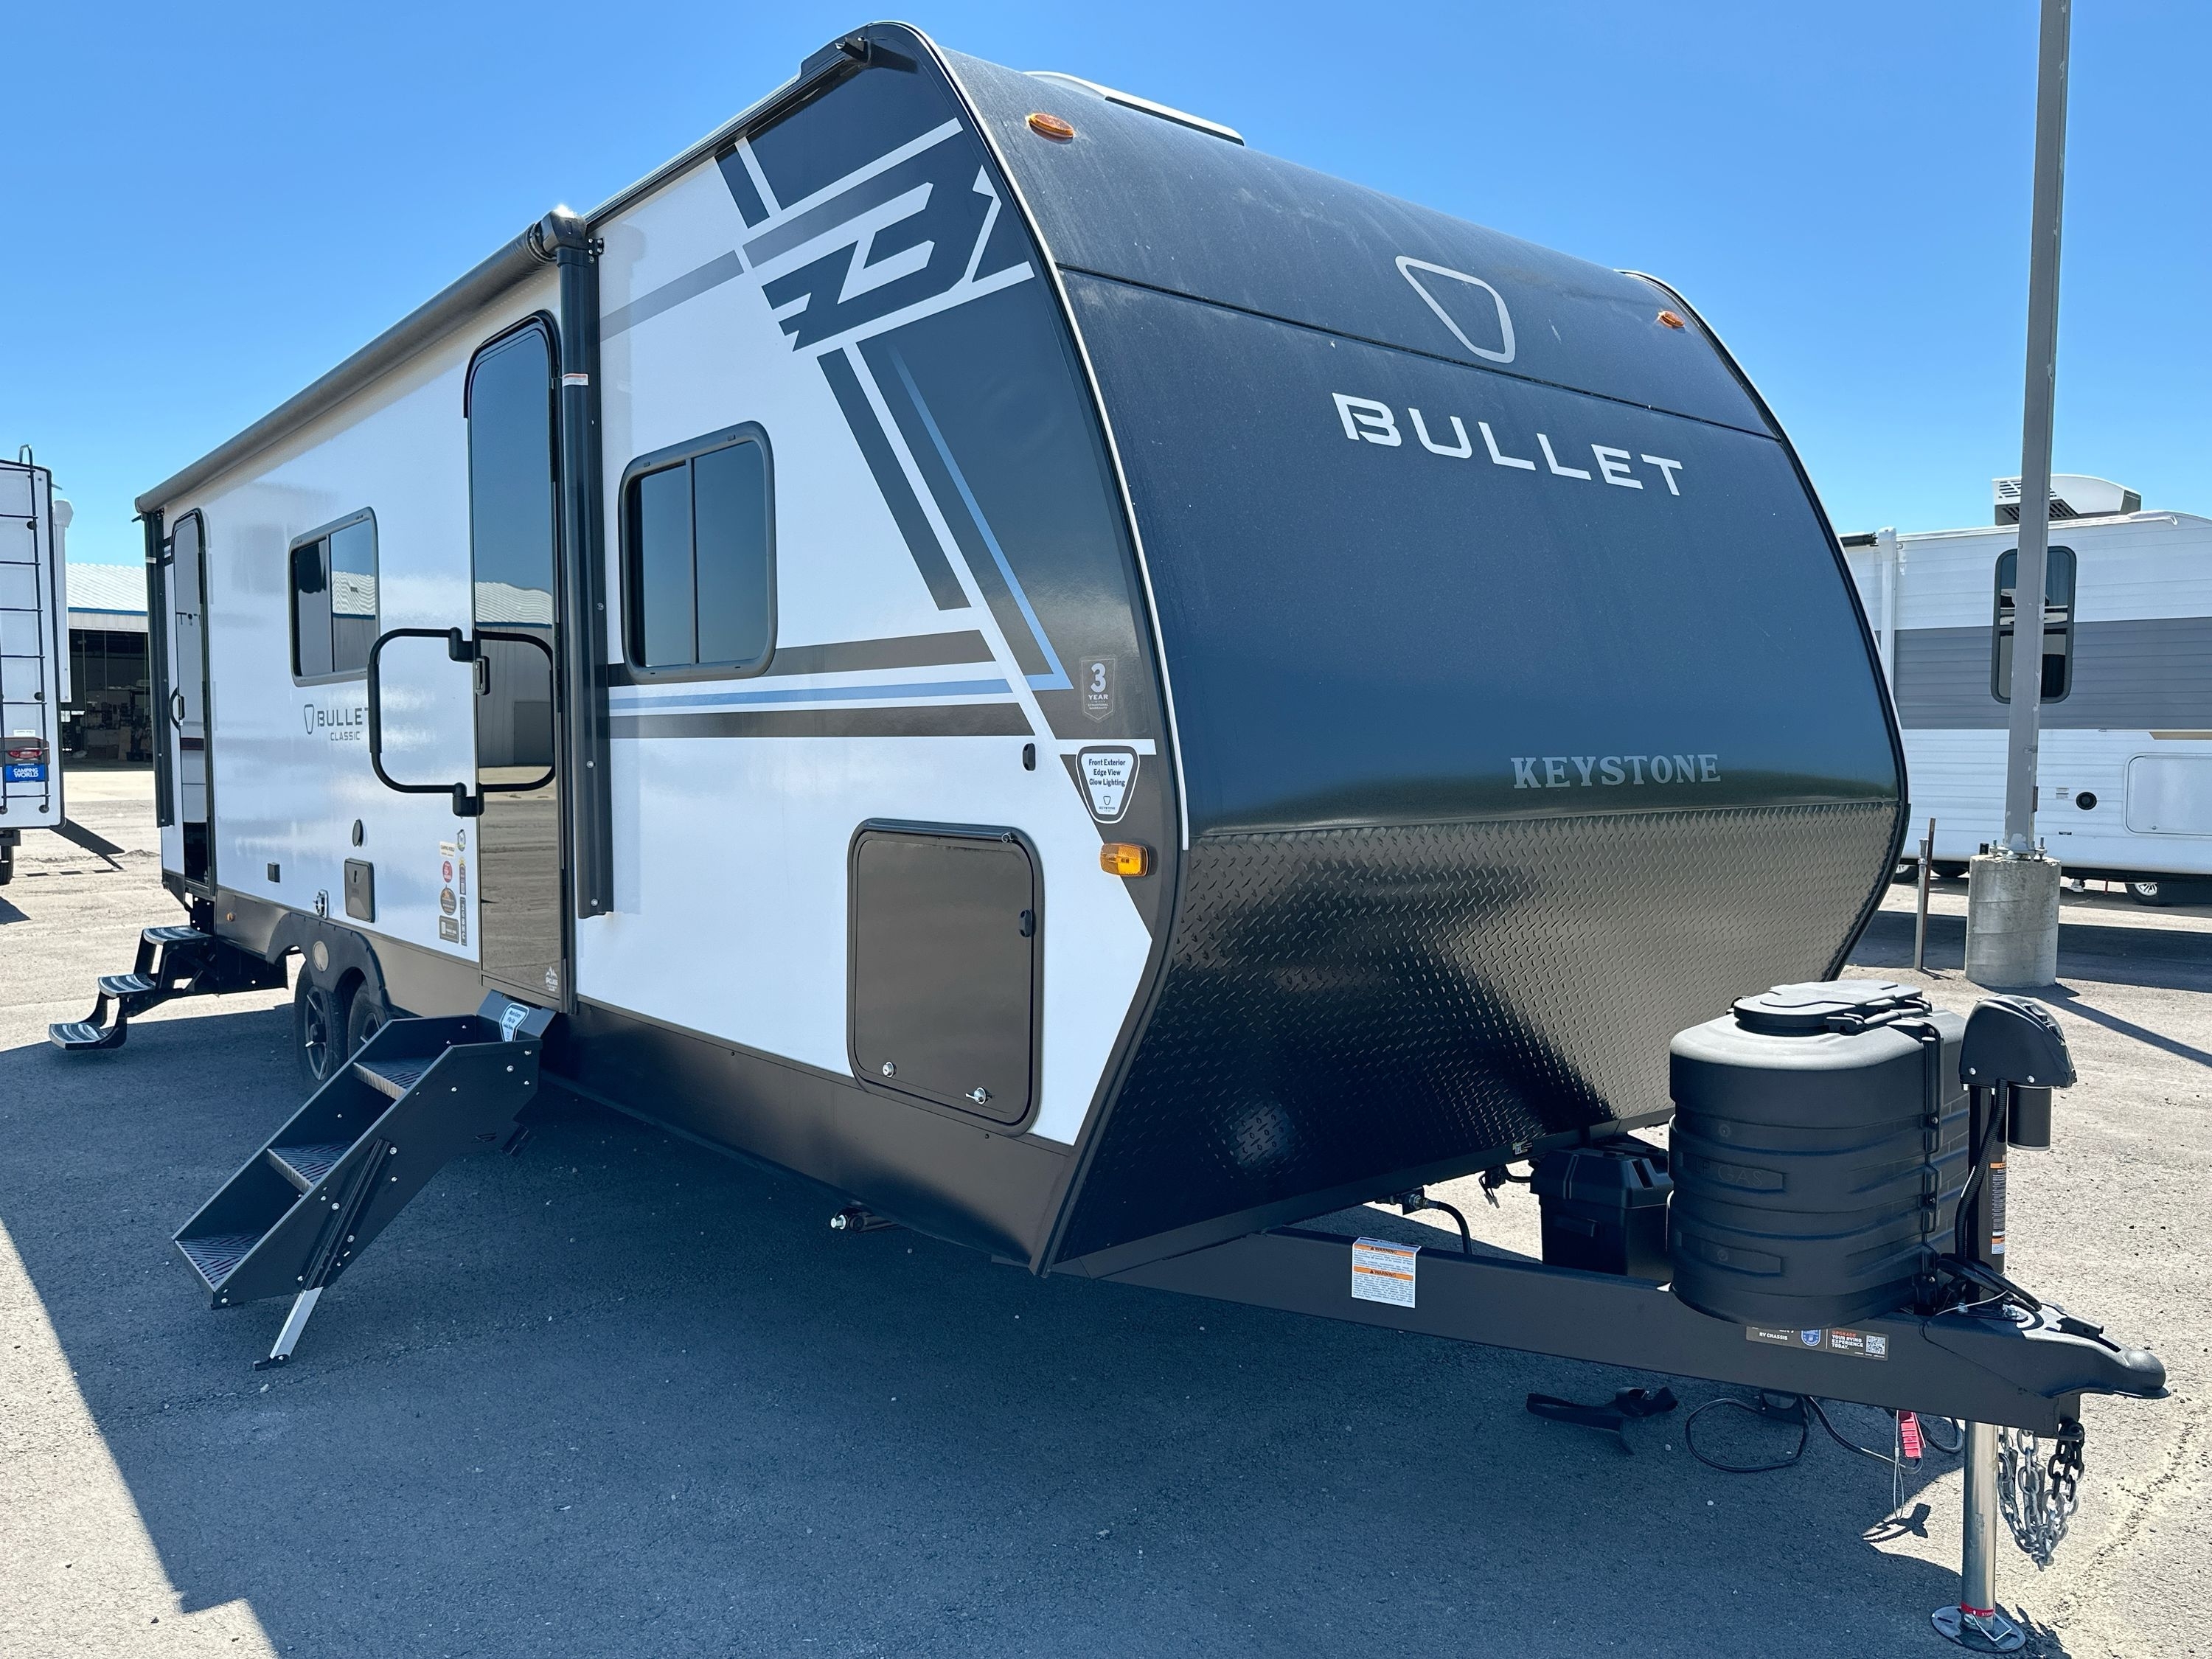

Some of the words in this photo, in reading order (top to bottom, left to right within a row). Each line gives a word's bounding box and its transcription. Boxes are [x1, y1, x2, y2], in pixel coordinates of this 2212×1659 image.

[1332, 392, 1683, 496] BULLET
[1090, 663, 1107, 693] 3
[330, 731, 360, 741] CLASSIC
[1088, 758, 1103, 766] Front
[1104, 758, 1126, 766] Exterior
[1093, 768, 1107, 777] Edge
[1510, 754, 1722, 790] KEYSTONE
[1103, 778, 1126, 787] Lighting
[1717, 1164, 1763, 1187] GAS
[1374, 1269, 1397, 1277] WARNING
[1832, 1338, 1864, 1348] EXPERIENCE
